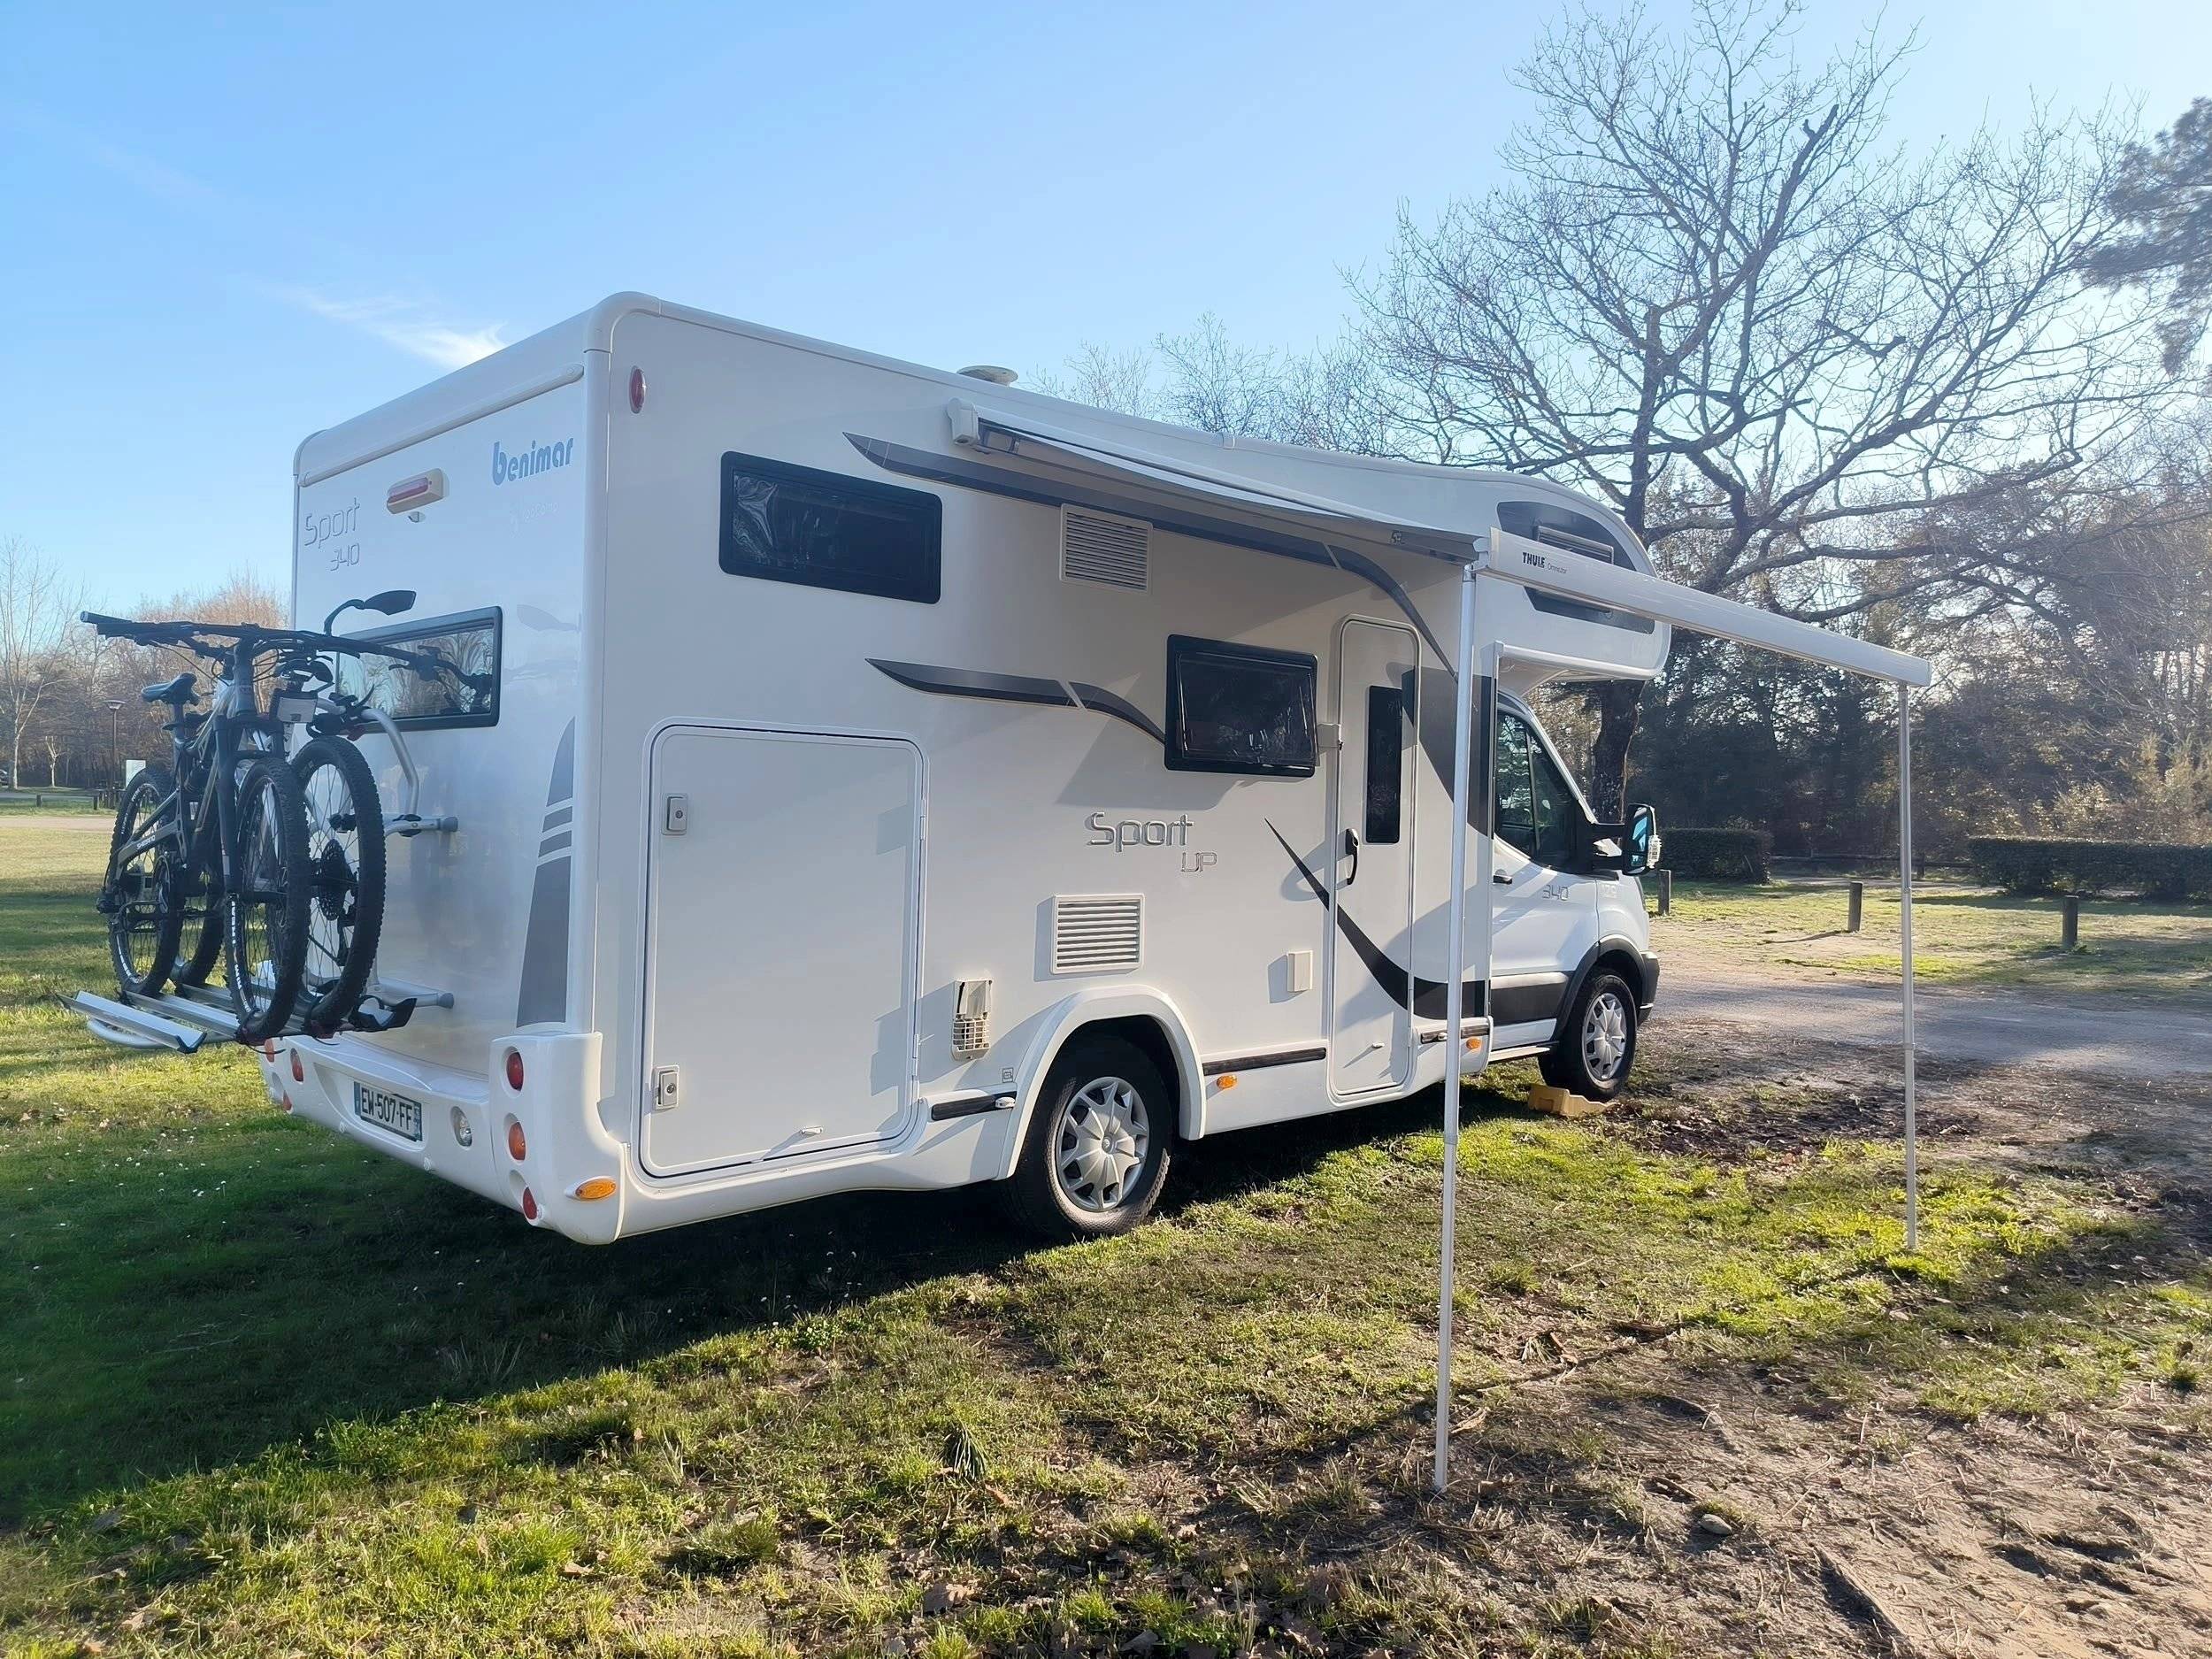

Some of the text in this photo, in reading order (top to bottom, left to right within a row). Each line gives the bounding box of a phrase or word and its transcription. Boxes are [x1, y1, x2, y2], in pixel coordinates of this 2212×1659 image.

[493, 437, 574, 486] benimar
[304, 497, 361, 549] Sport
[330, 543, 361, 572] 340
[1522, 552, 1546, 568] THULE
[1088, 811, 1194, 852] Sport
[1181, 851, 1217, 873] UP
[1542, 885, 1569, 901] 340
